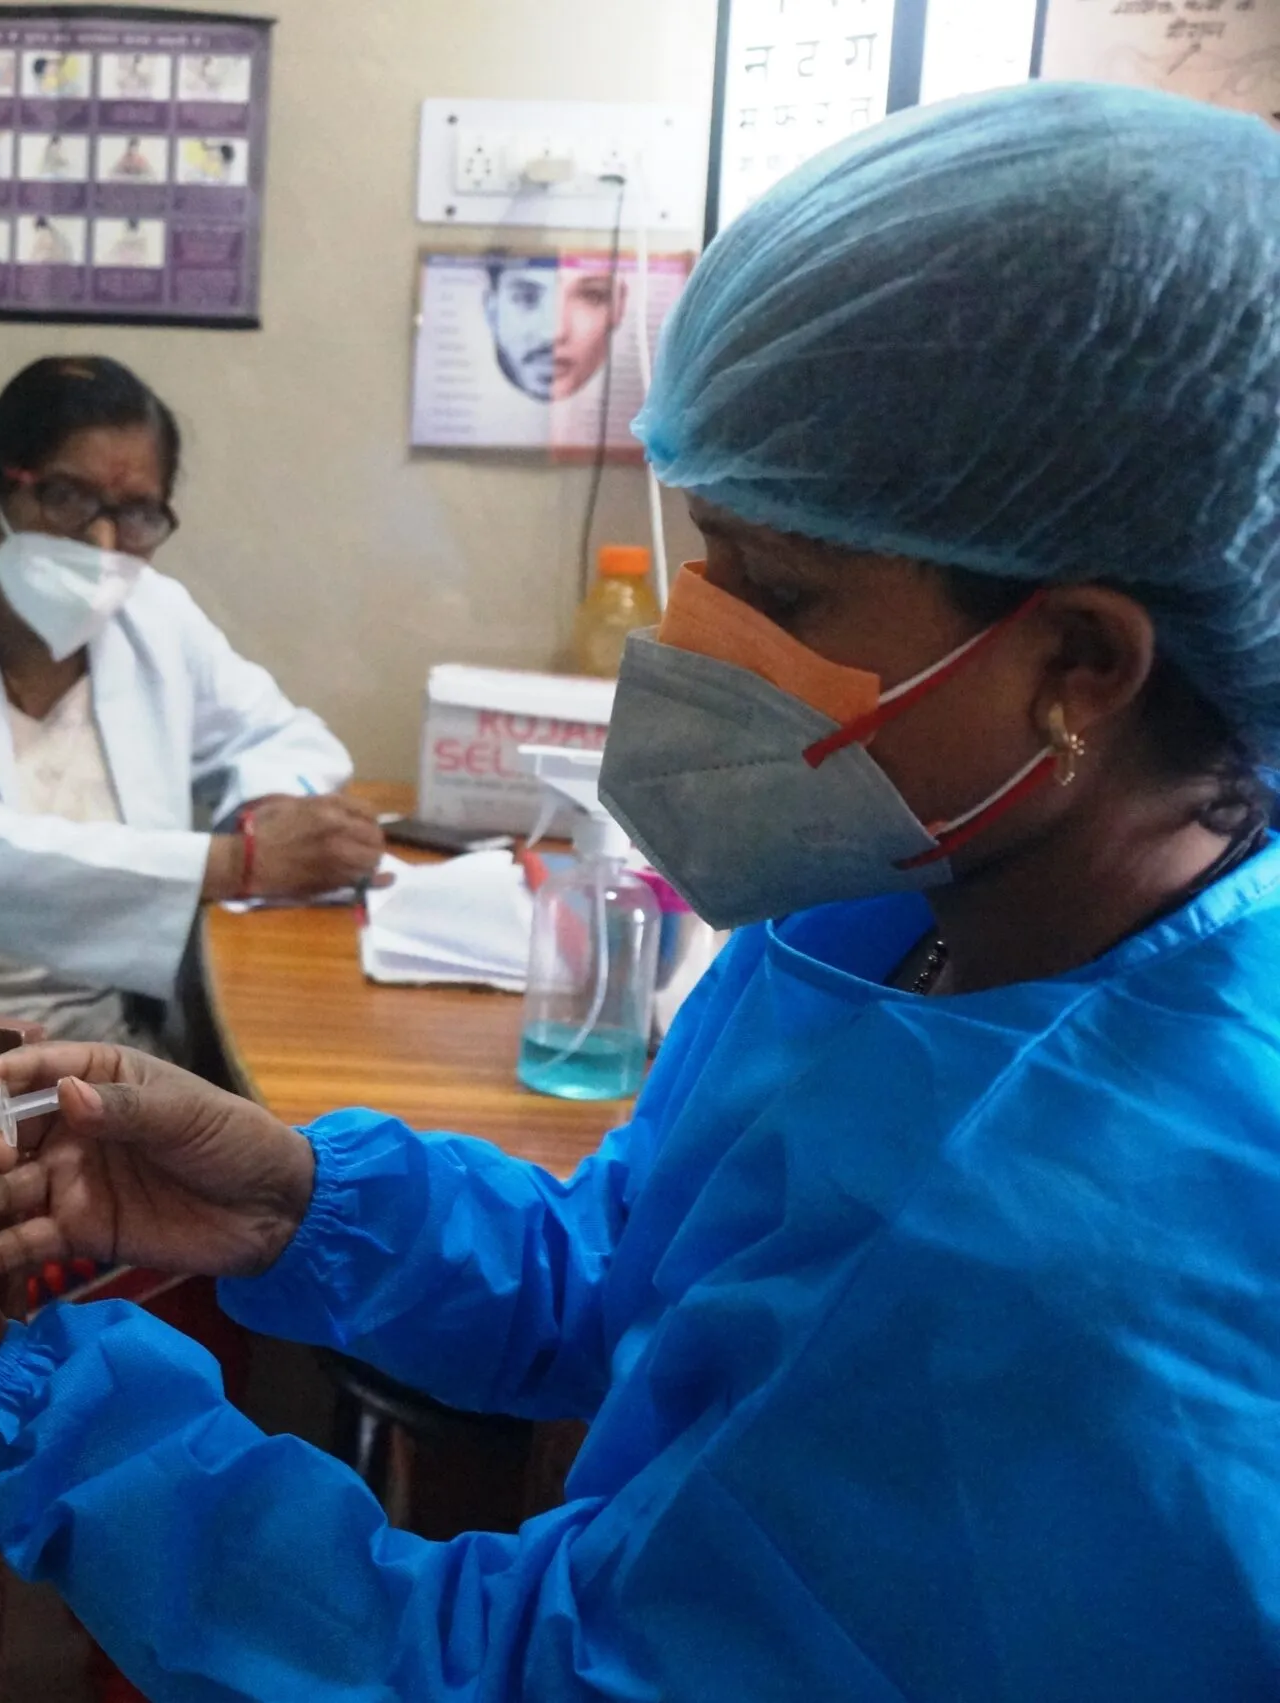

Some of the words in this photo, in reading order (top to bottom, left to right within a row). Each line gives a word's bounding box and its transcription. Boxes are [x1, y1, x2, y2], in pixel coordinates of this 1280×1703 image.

[745, 46, 775, 82] न
[796, 40, 820, 77] ट
[845, 33, 878, 71] ग
